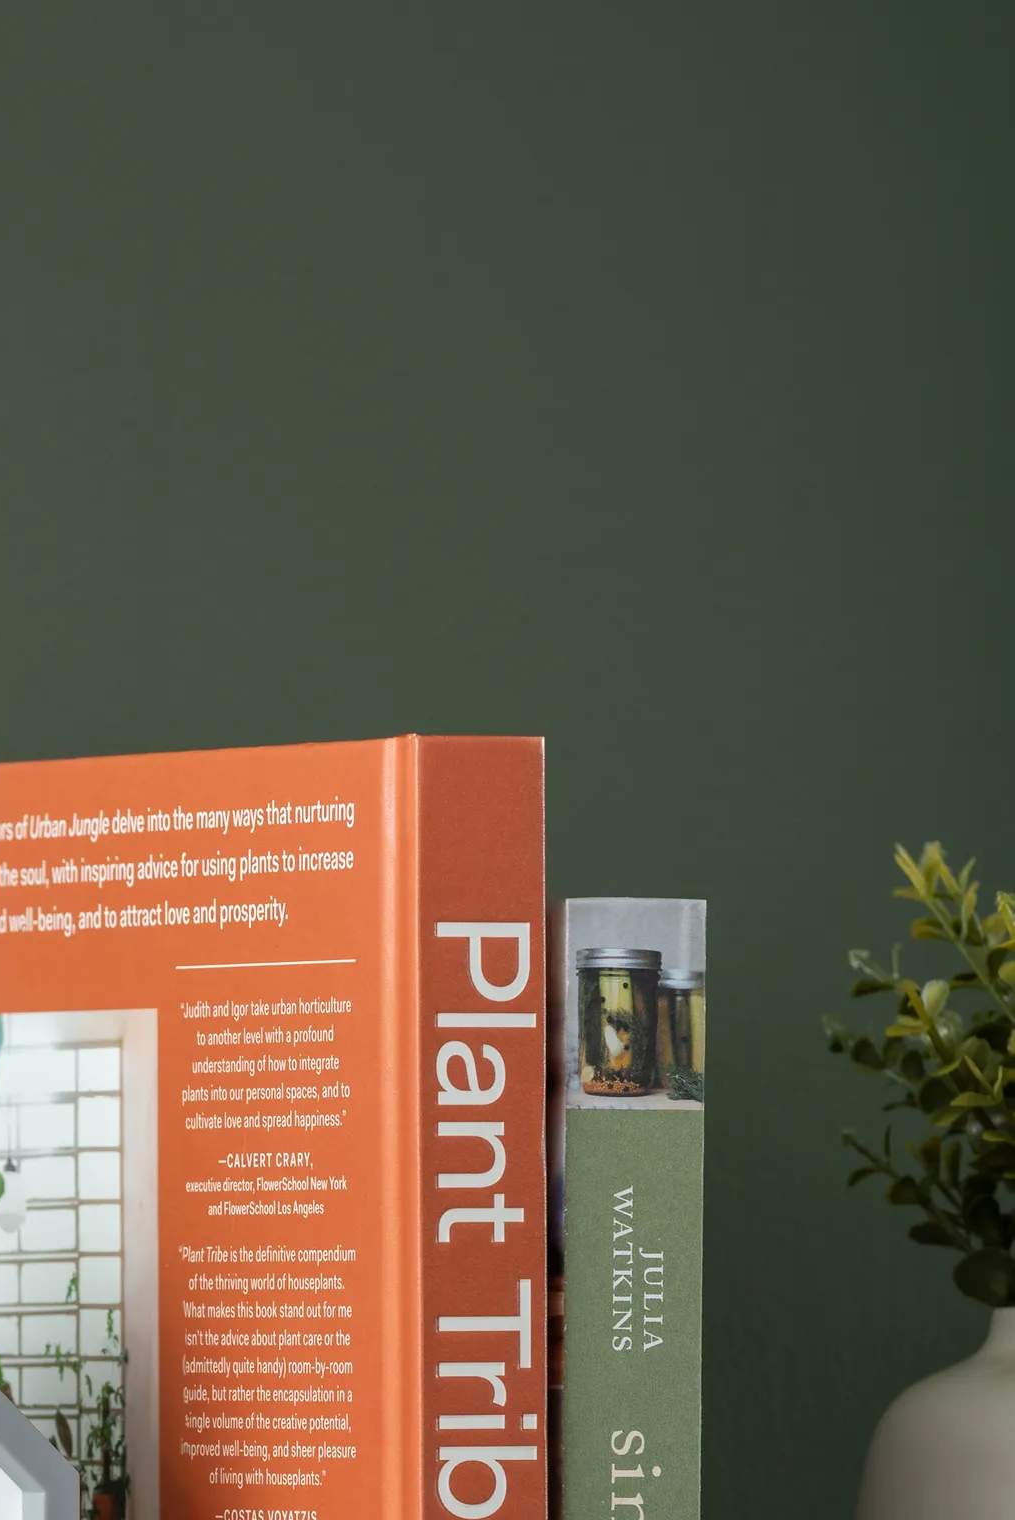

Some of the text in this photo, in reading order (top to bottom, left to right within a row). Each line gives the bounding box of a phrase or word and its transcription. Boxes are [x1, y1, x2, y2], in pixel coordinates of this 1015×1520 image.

[15, 815, 28, 840] of
[30, 814, 66, 839] Urban
[68, 811, 110, 842] Jungle
[112, 809, 144, 834] delve
[147, 808, 170, 831] into
[173, 806, 193, 830] the
[196, 811, 230, 834] many
[233, 808, 264, 833] ways
[266, 800, 292, 824] that
[295, 796, 354, 828] nurturing
[20, 860, 49, 887] soul,
[52, 859, 78, 883] with
[81, 856, 134, 888] inspiring
[137, 854, 178, 879] advice
[181, 853, 199, 877] for
[202, 851, 236, 881] using
[240, 849, 279, 881] plants
[282, 850, 295, 872] to
[299, 847, 353, 871] increase
[9, 907, 76, 937] well-being,
[78, 905, 102, 929] and
[104, 907, 117, 928] to
[120, 904, 162, 927] attract
[165, 901, 190, 925] love
[193, 900, 216, 924] and
[220, 898, 288, 929] prosperity.
[213, 1000, 229, 1017] and
[232, 1001, 249, 1021] Igor
[251, 1000, 269, 1016] take
[272, 999, 296, 1015] urban
[299, 997, 351, 1014] horticulture
[197, 1024, 333, 1047] to another level with a profound
[193, 1055, 339, 1076] understanding of how to integrate
[182, 1081, 350, 1105] plants into our personal spaces, and to
[434, 922, 536, 1242] Plant
[186, 1112, 222, 1129] cultivate
[224, 1112, 242, 1128] love
[244, 1112, 260, 1128] and
[262, 1111, 292, 1132] spread
[276, 1152, 313, 1168] CRARY,
[186, 1176, 346, 1193] executive director, FlowerSchool New York
[208, 1200, 324, 1218] and FlowerSchool Los Angeles
[612, 1186, 633, 1351] WATKINS
[189, 1273, 344, 1294] of the thriving world of houseplants.
[183, 1301, 352, 1318] What makes this book stand out for me
[639, 1248, 663, 1352] JULIA
[210, 1468, 218, 1484] of
[220, 1467, 243, 1489] living
[245, 1468, 263, 1484] with
